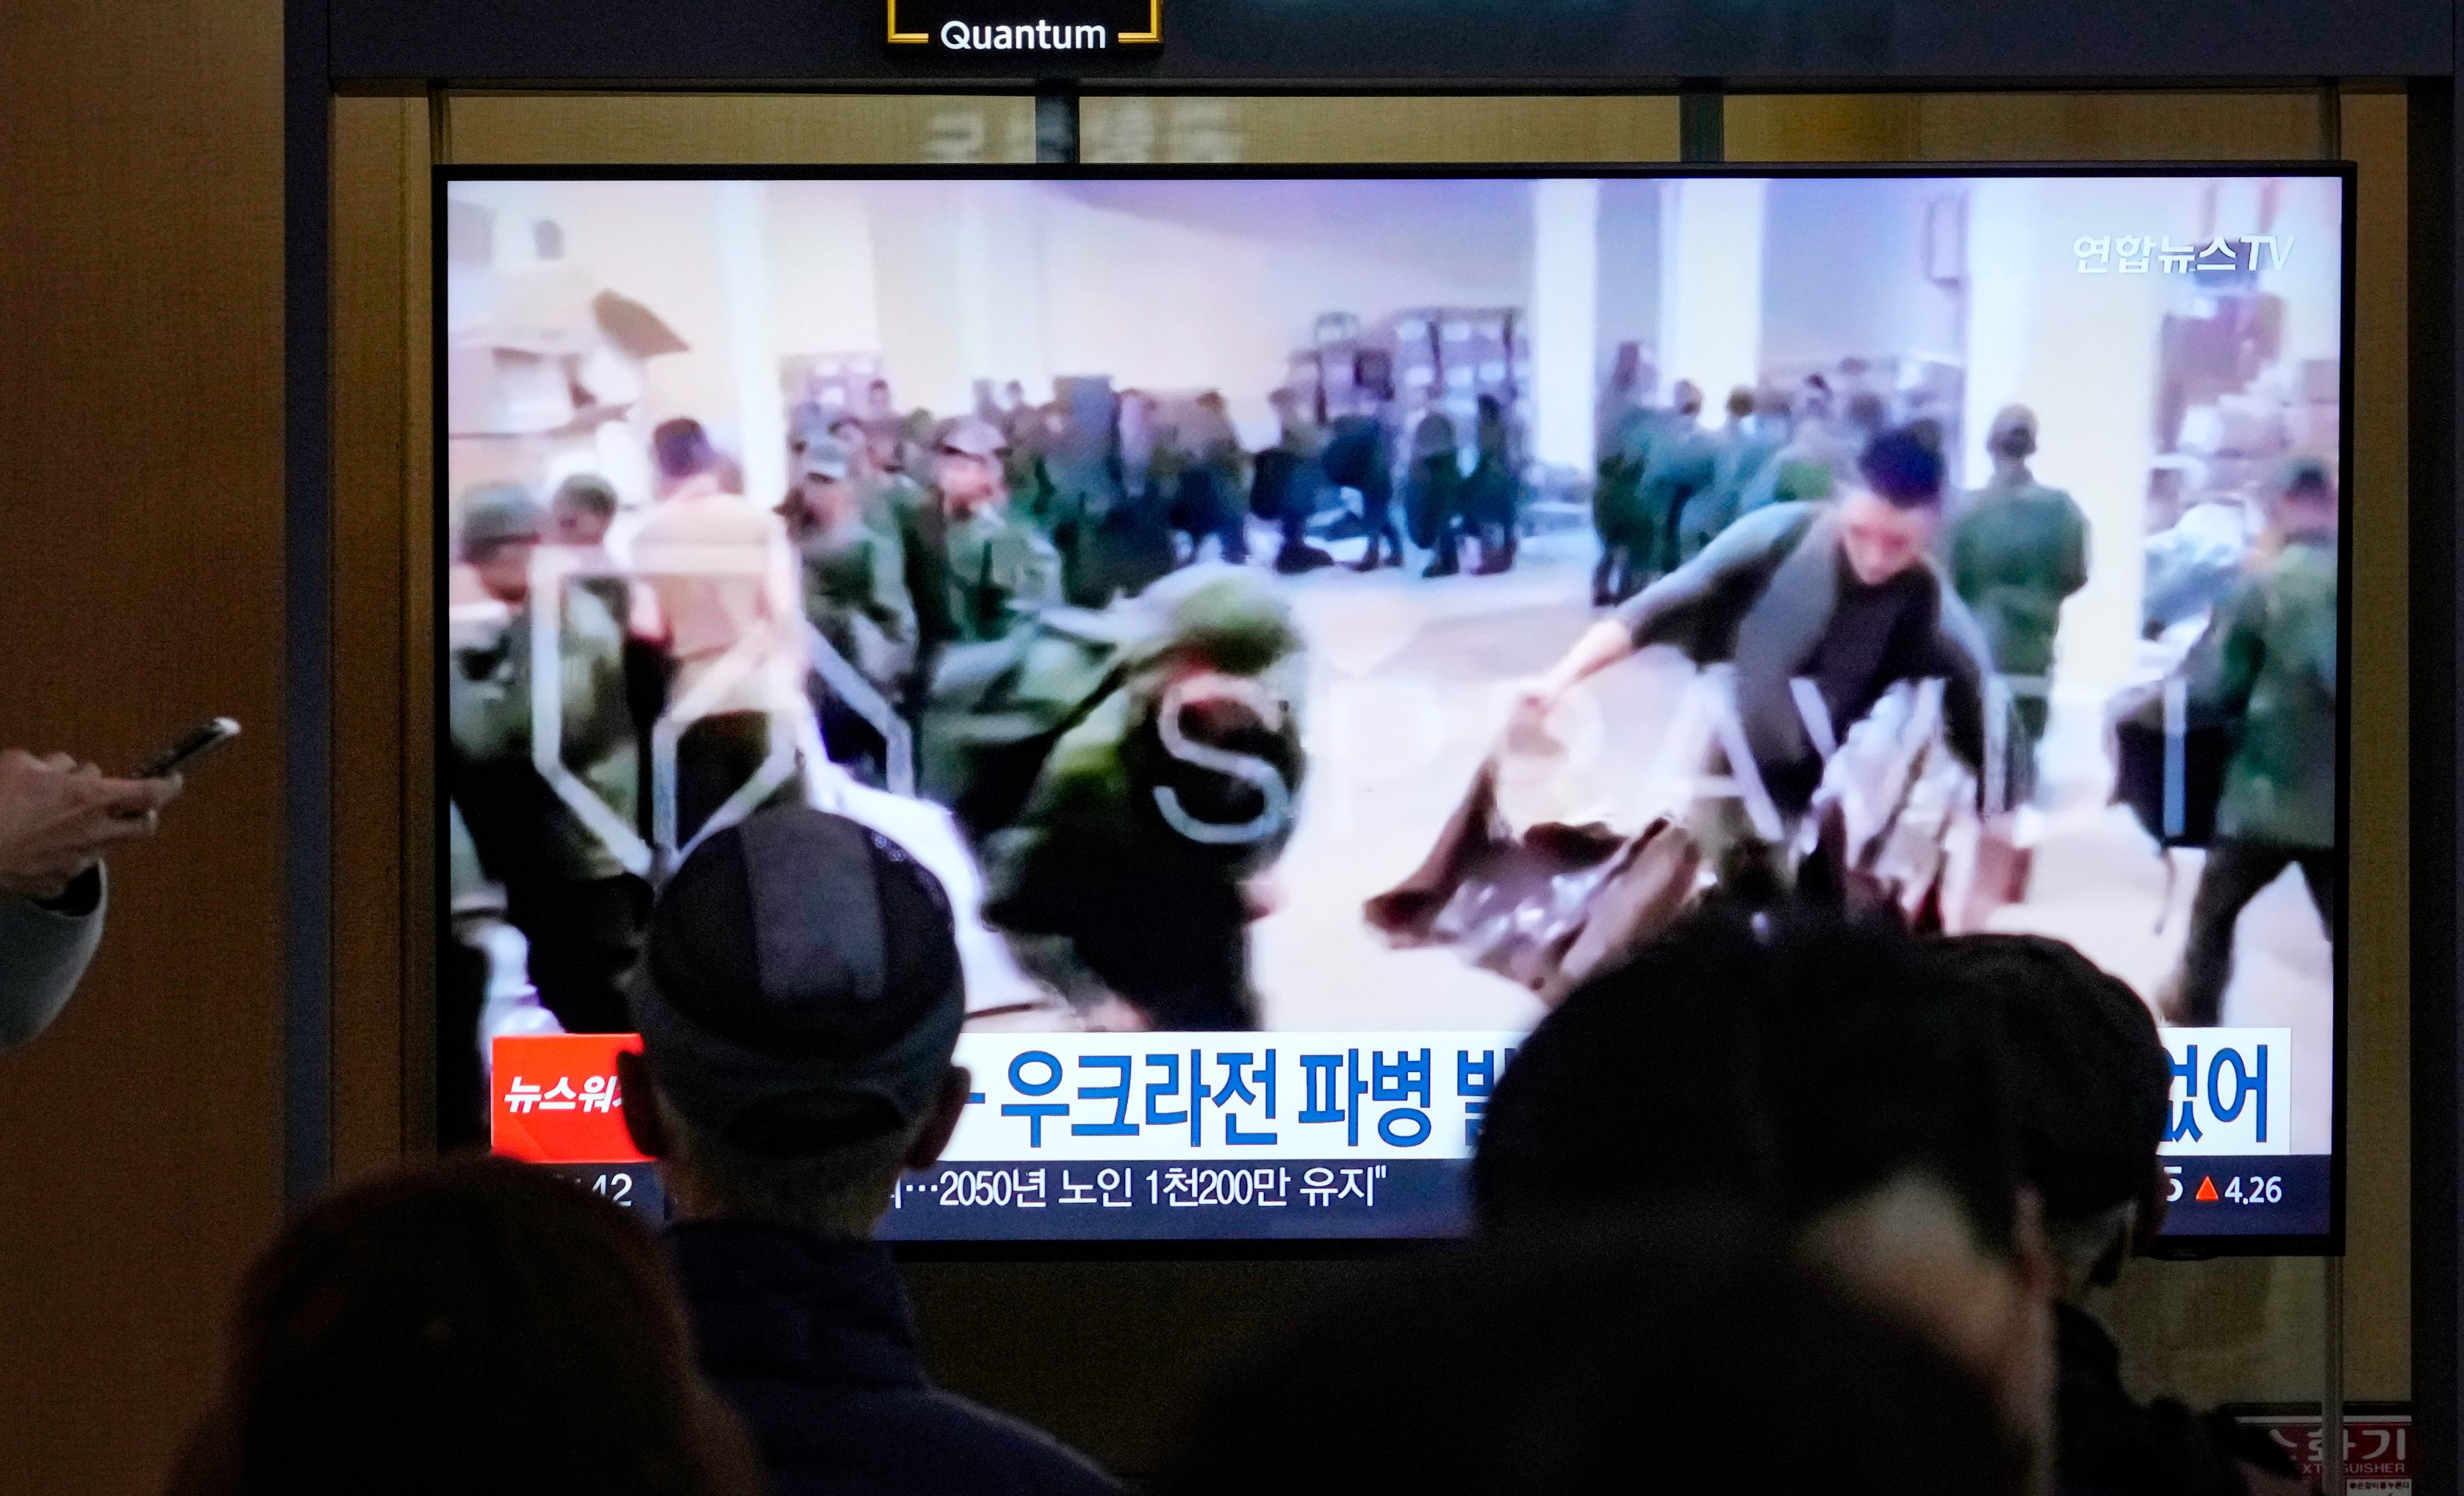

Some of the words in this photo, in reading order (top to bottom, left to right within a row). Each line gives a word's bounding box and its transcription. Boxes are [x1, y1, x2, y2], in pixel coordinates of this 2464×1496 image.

[941, 19, 1106, 49] Quantum
[2072, 235, 2296, 273] 연합뉴스TV
[504, 1076, 624, 1113] 뉴스워
[1000, 1048, 1278, 1147] 우크라전
[1299, 1048, 1431, 1147] 파병
[1059, 1168, 1132, 1207] 노인
[1145, 1167, 1291, 1207] 1천200만
[1300, 1165, 1387, 1207] 유지"
[2225, 1176, 2282, 1204] 4.26
